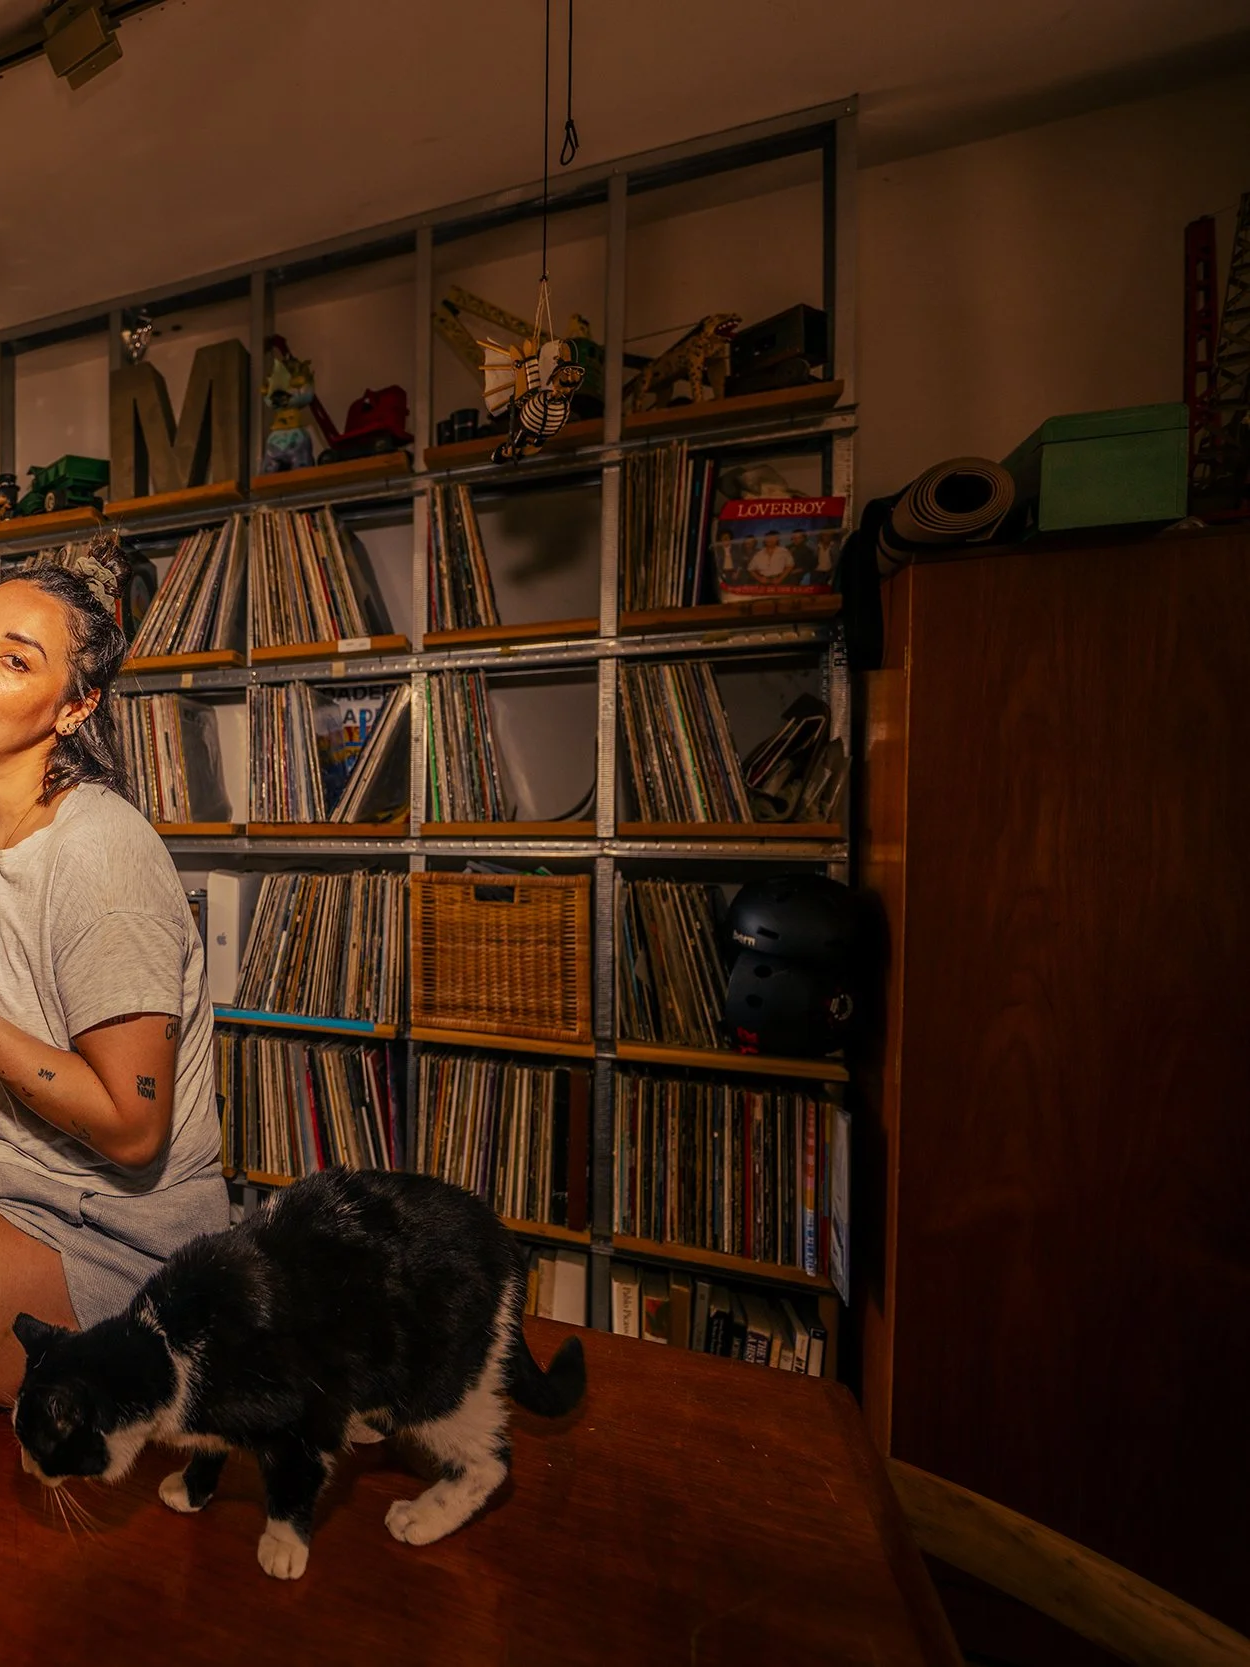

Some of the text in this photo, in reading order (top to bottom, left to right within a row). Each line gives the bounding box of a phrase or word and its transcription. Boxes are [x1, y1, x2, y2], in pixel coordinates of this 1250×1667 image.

[109, 339, 250, 501] M
[737, 501, 826, 517] LOVERBOY
[136, 1074, 156, 1088] SUPER
[137, 1084, 157, 1101] NOVA
